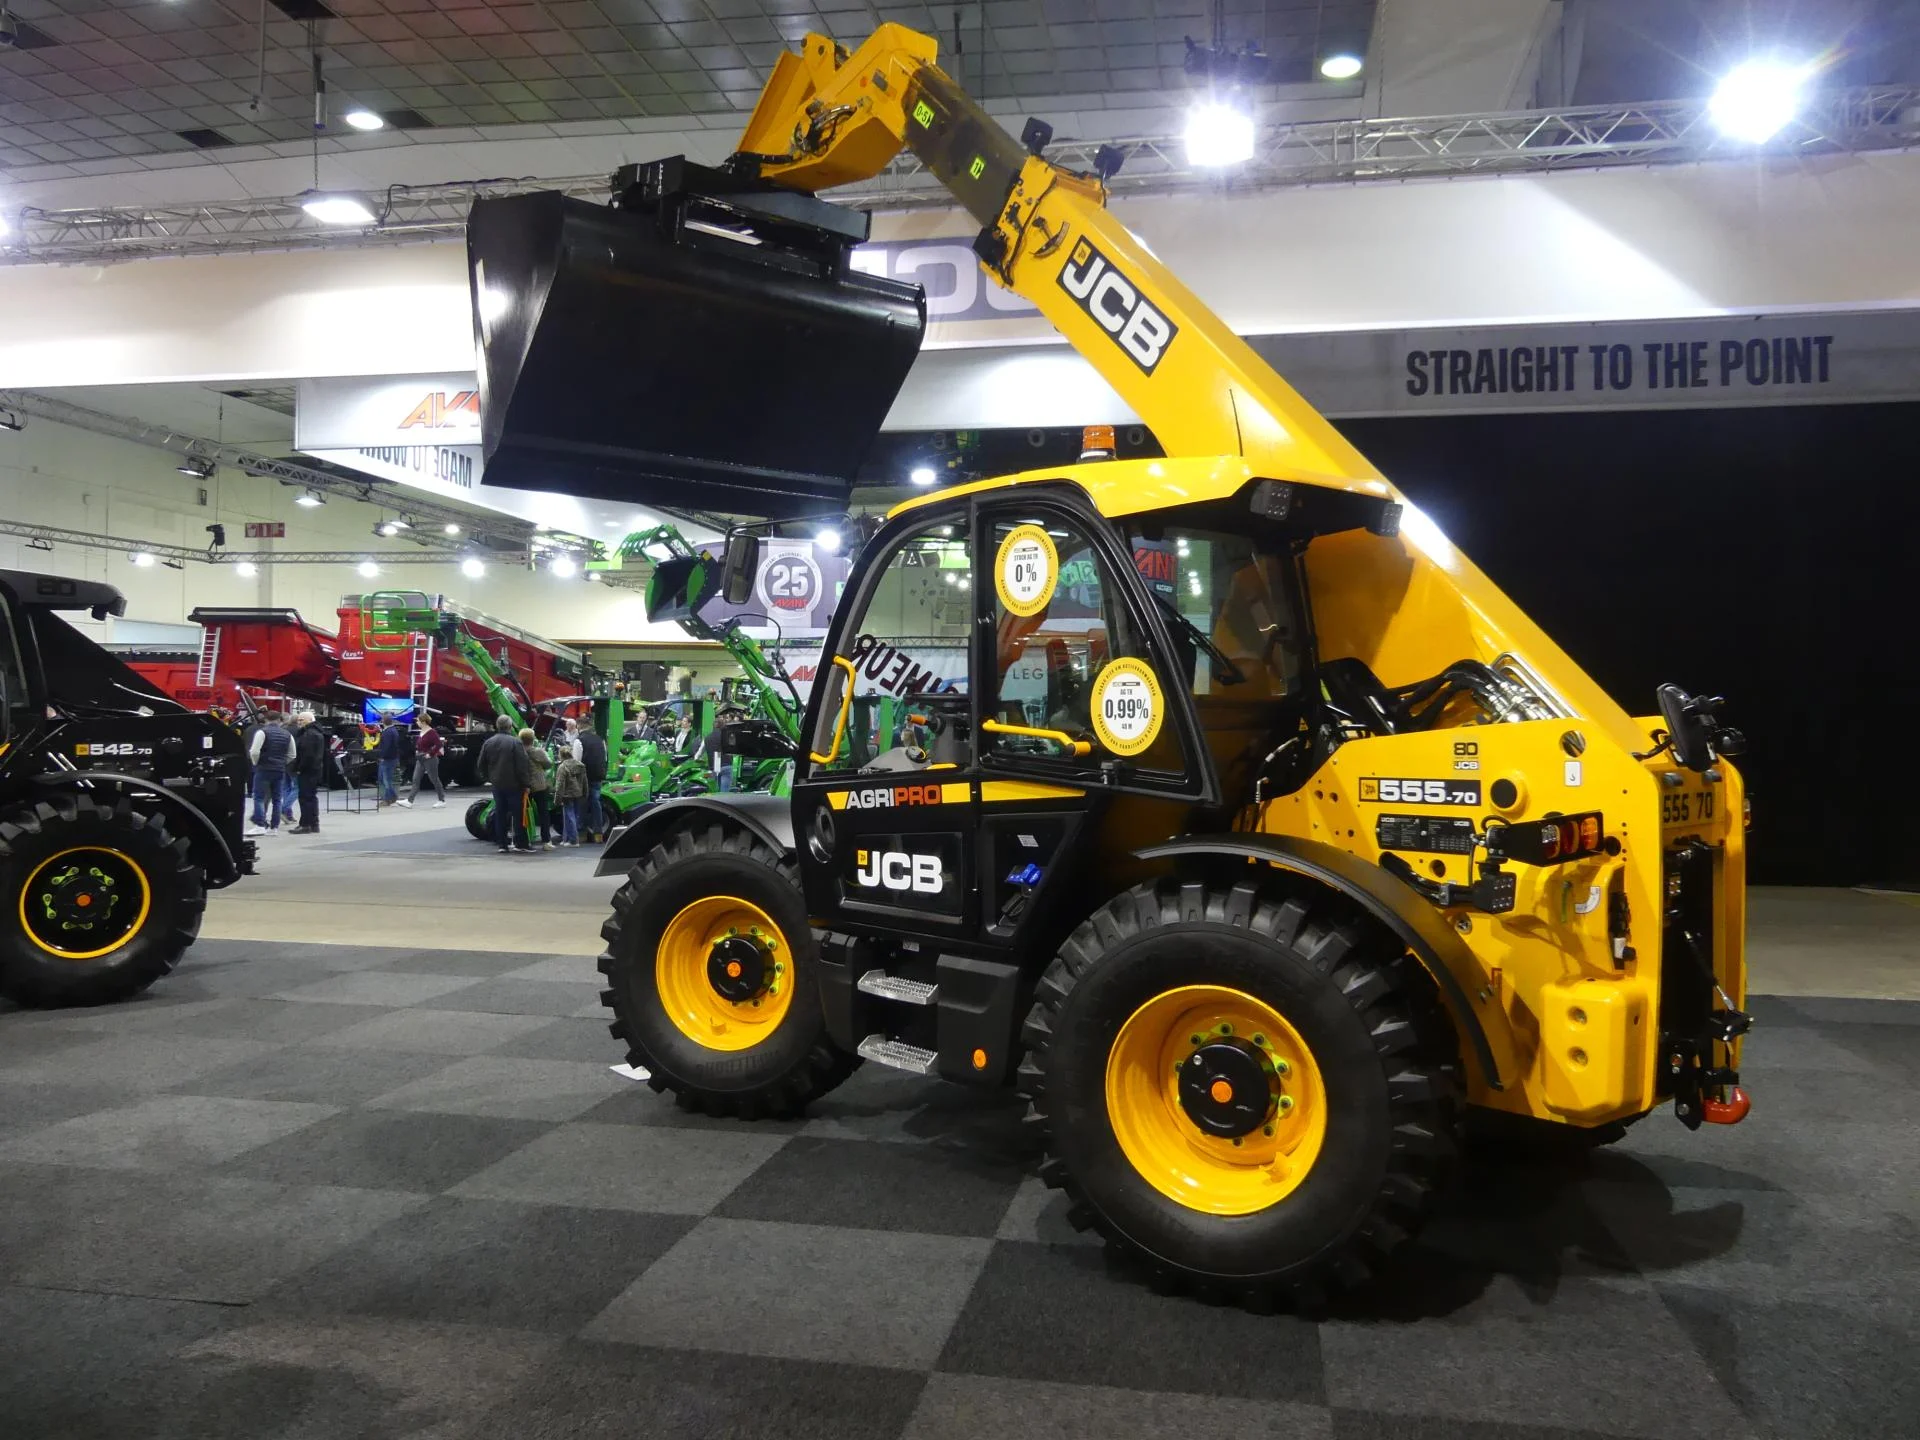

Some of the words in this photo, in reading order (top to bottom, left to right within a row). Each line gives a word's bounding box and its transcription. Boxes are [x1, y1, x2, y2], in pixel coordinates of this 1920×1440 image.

[1062, 256, 1170, 368] JCB
[1406, 345, 1579, 396] STRAIGHT
[1588, 344, 1632, 391] TO
[1643, 341, 1709, 389] THE
[1719, 335, 1834, 387] POINT
[772, 564, 809, 597] 25
[1105, 698, 1149, 720] 0,99%
[1453, 760, 1479, 770] JCB
[1454, 742, 1478, 756] 80
[846, 785, 942, 810] AGRIPRO
[1663, 793, 1689, 823] 555
[1696, 791, 1713, 819] 70
[857, 850, 943, 894] JCB
